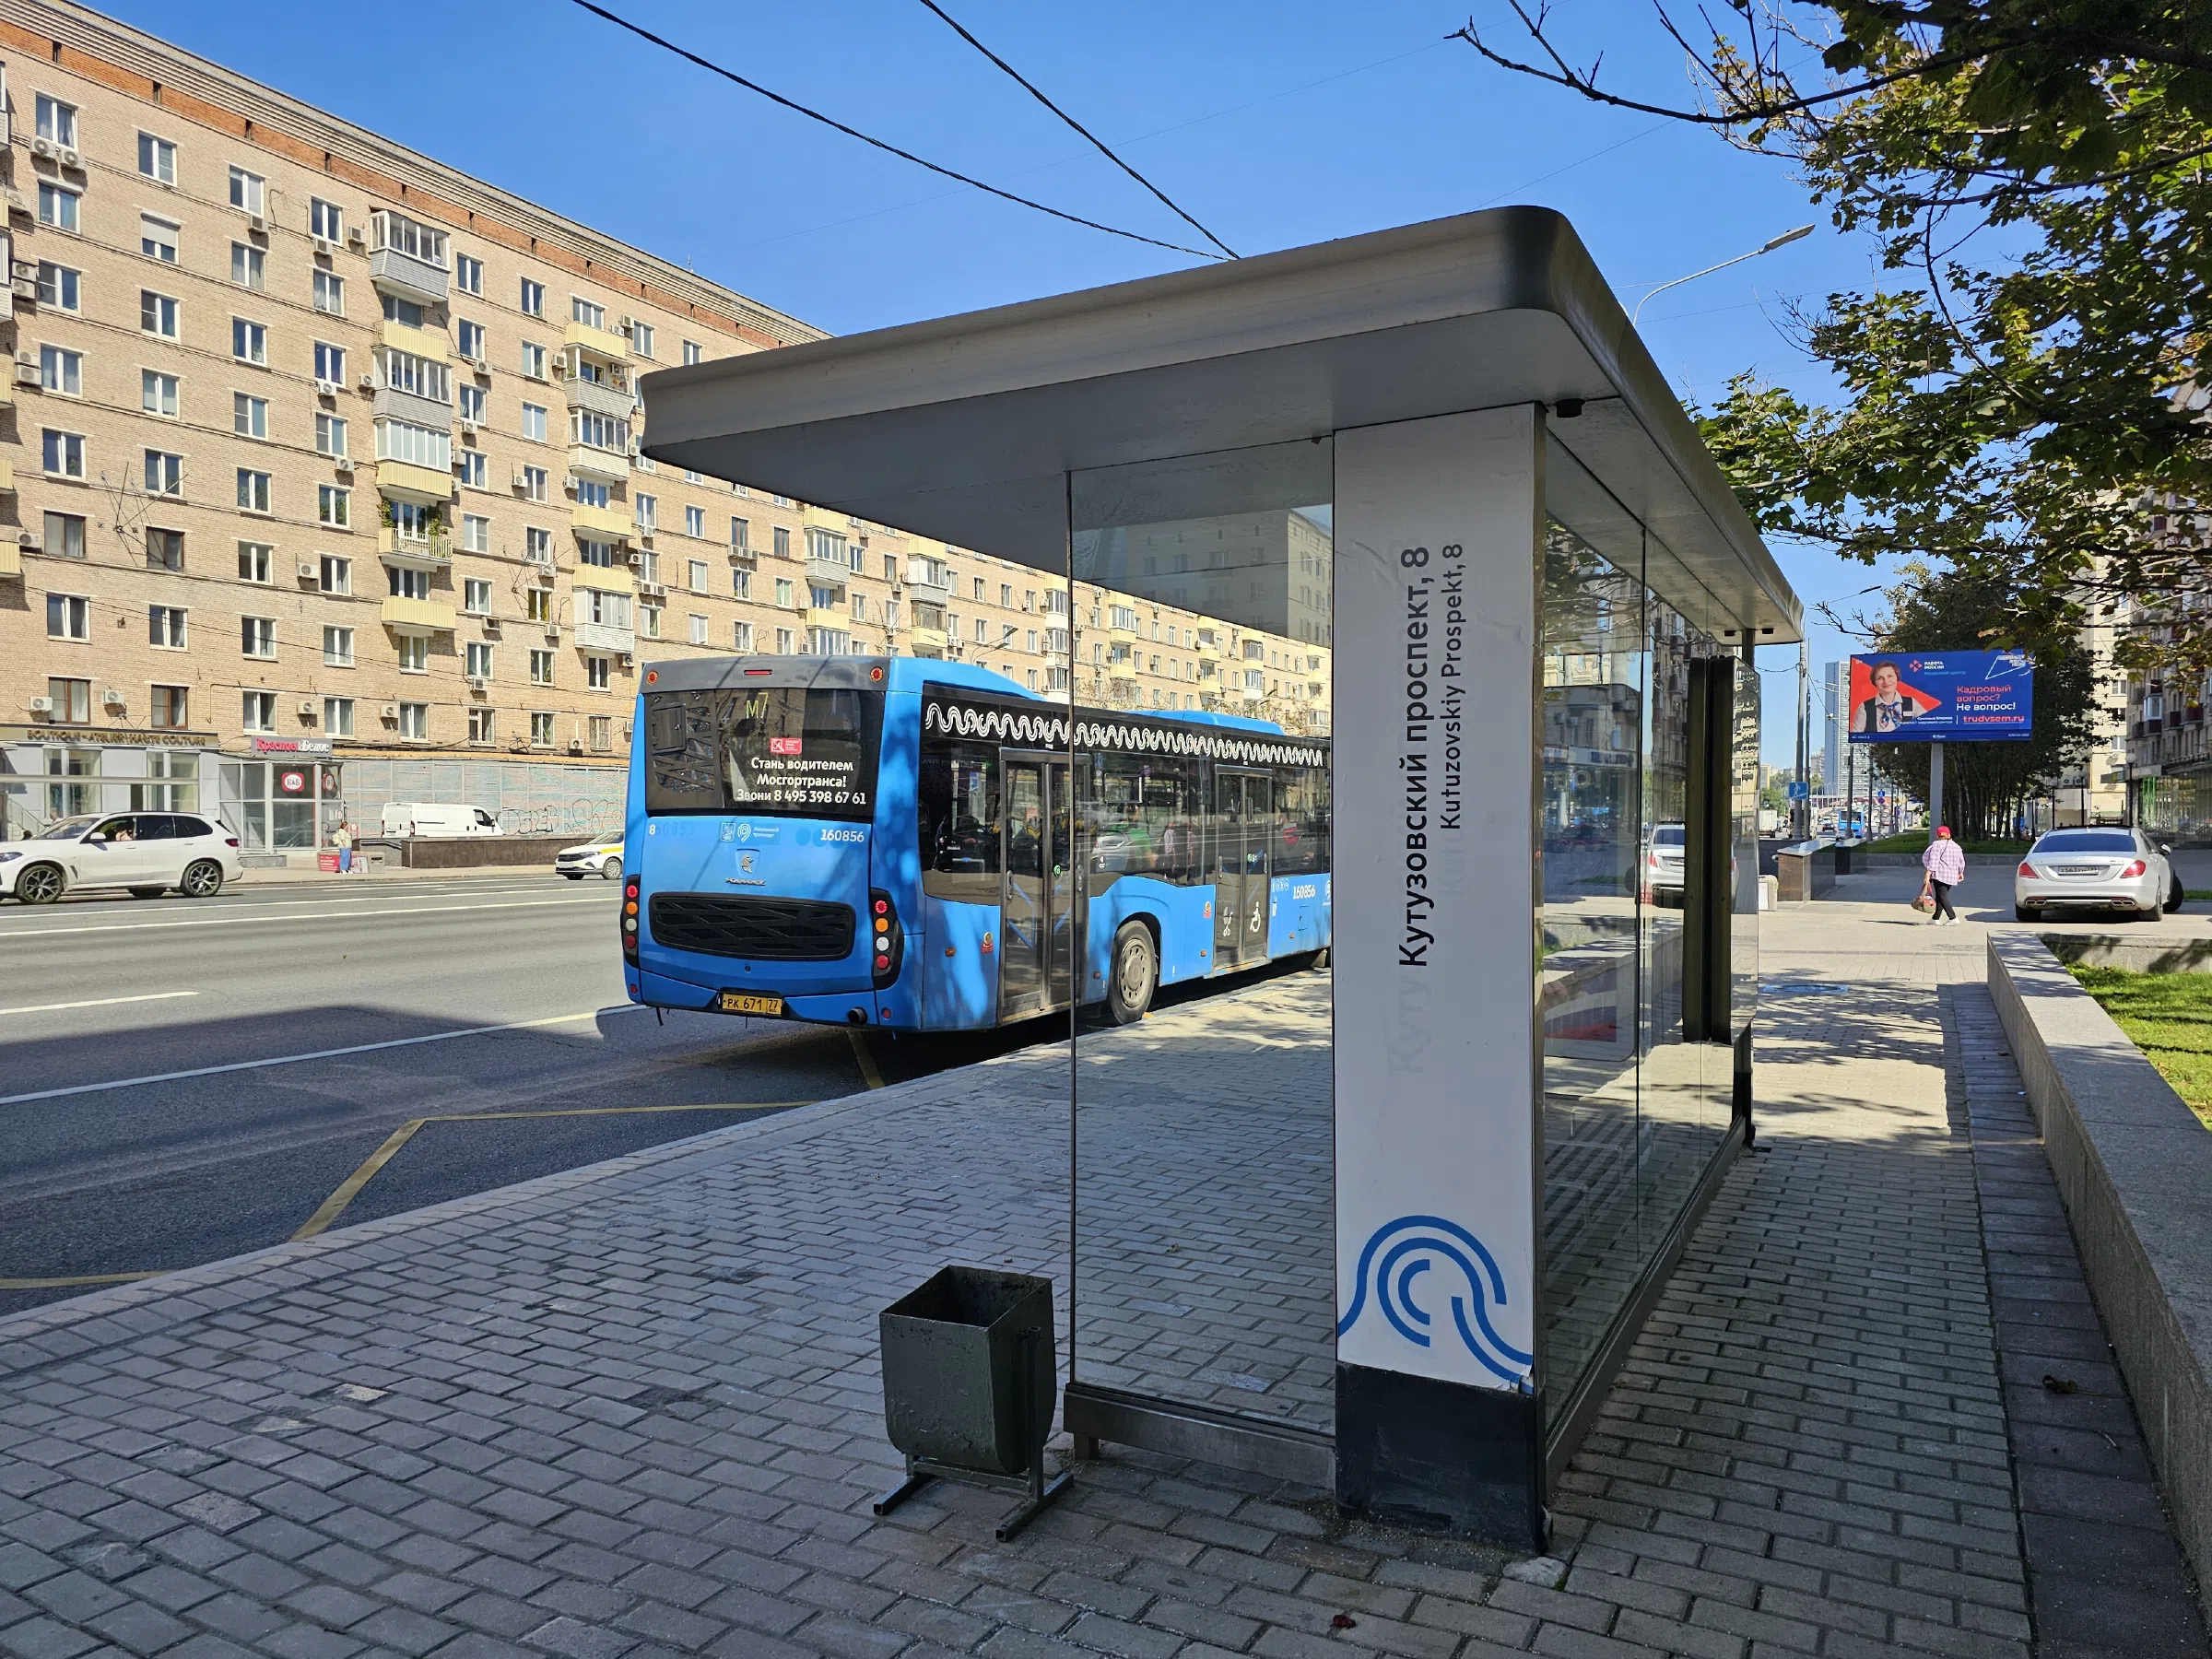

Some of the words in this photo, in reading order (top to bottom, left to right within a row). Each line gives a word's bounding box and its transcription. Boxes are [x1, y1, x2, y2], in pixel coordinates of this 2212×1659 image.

[1400, 547, 1430, 568] 8
[1441, 544, 1463, 559] 8
[1441, 565, 1466, 677] Prospekt,
[1406, 578, 1435, 742] проспект,
[1957, 685, 2012, 694] Кадровый
[1957, 694, 2001, 703] вопрос?
[1956, 703, 1971, 712] Не
[1973, 702, 2017, 712] вопрос!
[751, 757, 785, 770] Стань
[787, 760, 854, 771] водителем
[1440, 686, 1466, 830] Kutuzovskiy
[757, 773, 847, 788] Мосгортранса!
[736, 789, 771, 801] Звони
[774, 789, 782, 801] 8
[784, 790, 807, 802] 495
[809, 791, 832, 804] 398
[834, 792, 850, 804] 67
[852, 793, 866, 805] 61
[820, 829, 865, 842] 160856
[1398, 755, 1435, 967] Кутузовский
[727, 998, 739, 1009] РК
[743, 998, 762, 1010] 671
[769, 999, 778, 1009] 77
